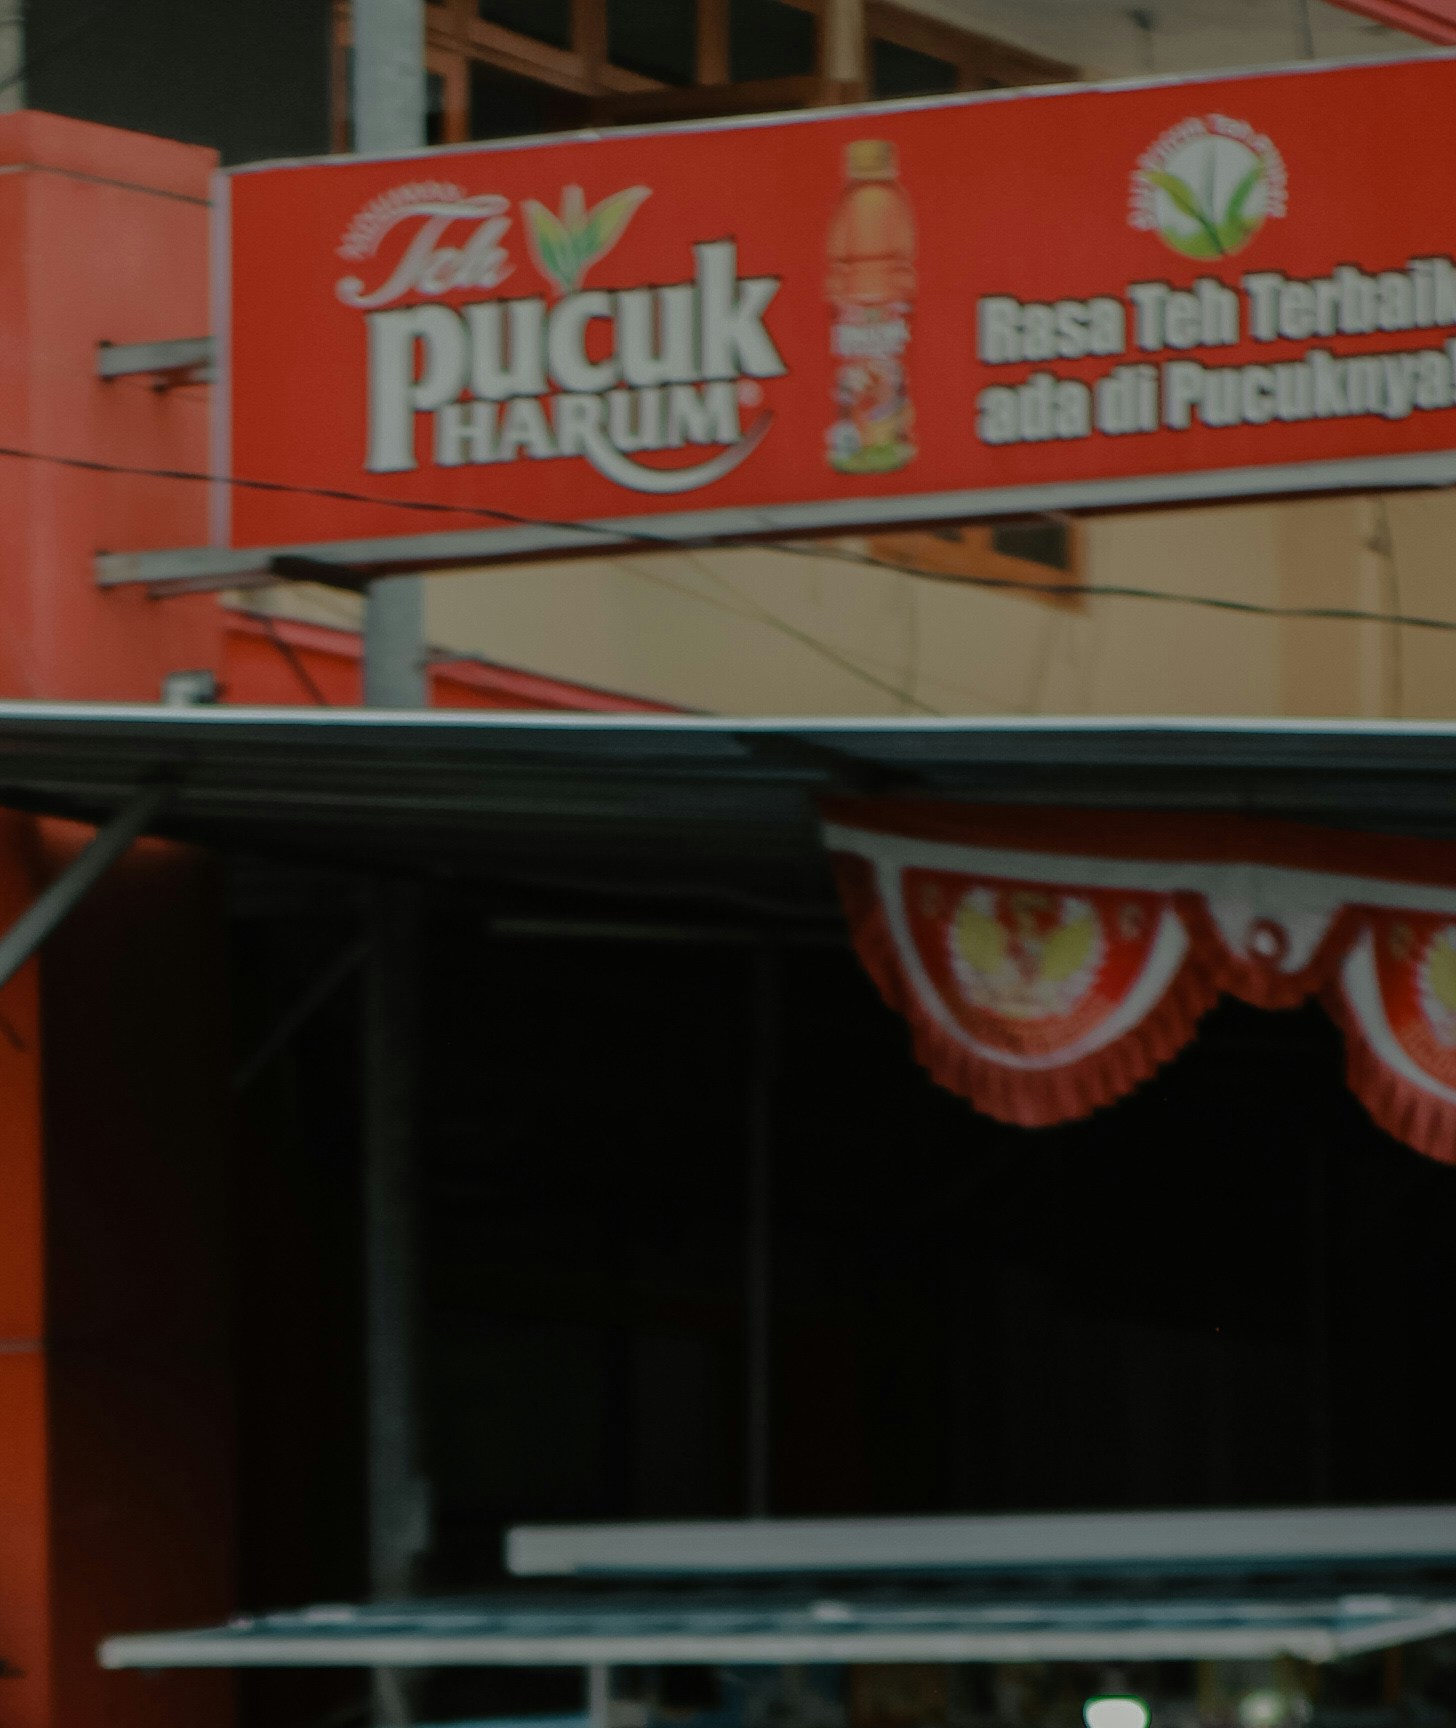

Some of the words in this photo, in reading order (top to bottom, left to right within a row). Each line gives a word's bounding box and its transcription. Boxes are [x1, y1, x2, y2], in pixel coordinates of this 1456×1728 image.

[334, 194, 517, 309] Teh
[977, 293, 1126, 365] Rasa
[1128, 276, 1240, 353] Teh
[434, 380, 751, 478] HARUM
[976, 369, 1092, 445] ada
[1094, 361, 1159, 436] di
